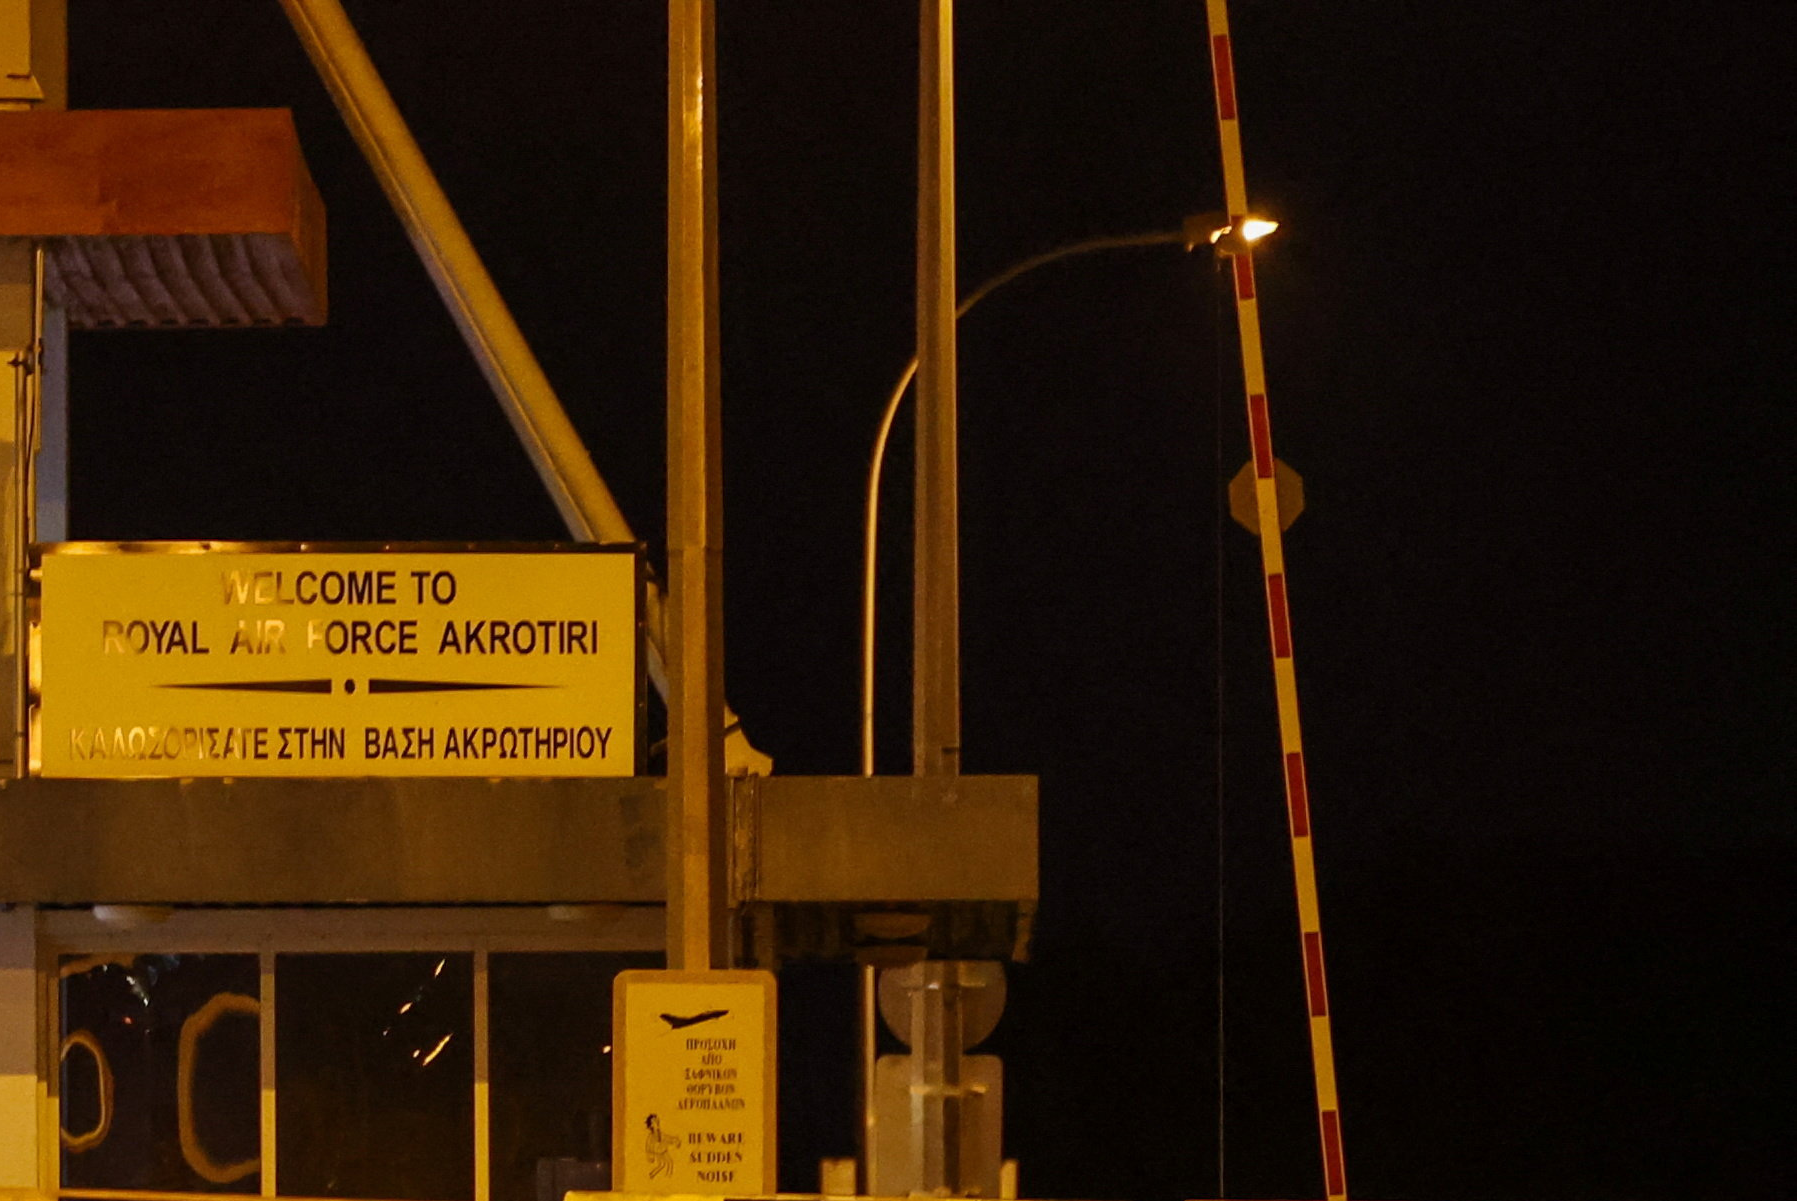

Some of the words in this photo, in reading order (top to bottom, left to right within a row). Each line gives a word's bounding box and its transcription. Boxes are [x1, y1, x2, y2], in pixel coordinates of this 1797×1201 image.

[220, 570, 397, 605] WELCOME
[410, 570, 457, 605] TO
[102, 620, 210, 655] ROYAL
[229, 620, 286, 655] AIR
[306, 619, 418, 655] FORCE
[438, 620, 598, 655] AKROTIRI
[277, 726, 346, 760] ΣΤΗΝ
[364, 726, 435, 760] ΒΑΣΗ
[443, 726, 613, 760] ΑΚΡΩΤΗΡΙΟΥ
